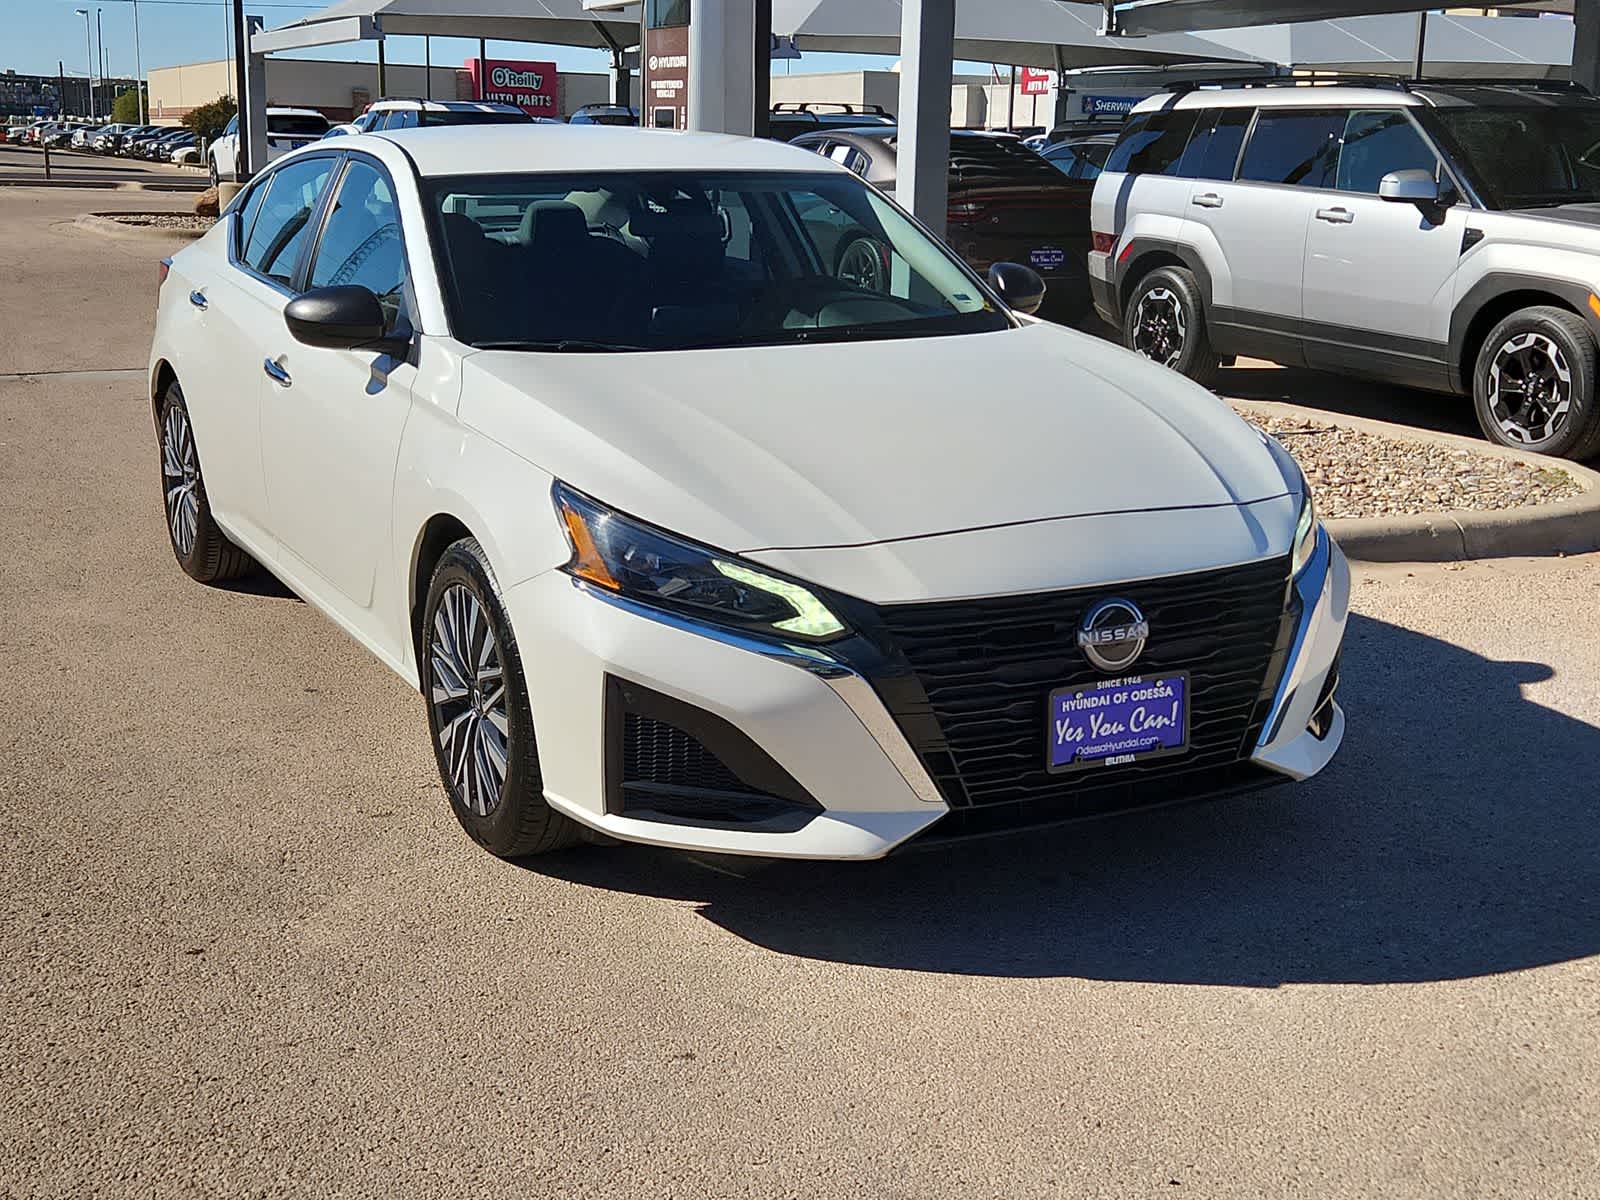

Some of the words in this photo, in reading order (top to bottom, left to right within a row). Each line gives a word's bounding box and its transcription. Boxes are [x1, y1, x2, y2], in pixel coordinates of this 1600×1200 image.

[491, 67, 543, 90] O'Reilly
[517, 93, 552, 107] PARTS
[1079, 620, 1149, 643] NISSAN
[1096, 679, 1121, 690] SINCE
[1062, 696, 1110, 713] HYUNDAI
[1113, 692, 1129, 705] OF
[1130, 686, 1174, 702] ODESSA
[1055, 717, 1085, 745] Yes
[1089, 712, 1126, 739] You
[1129, 700, 1179, 733] Can!
[1075, 735, 1160, 756] OdessaHyundai.com
